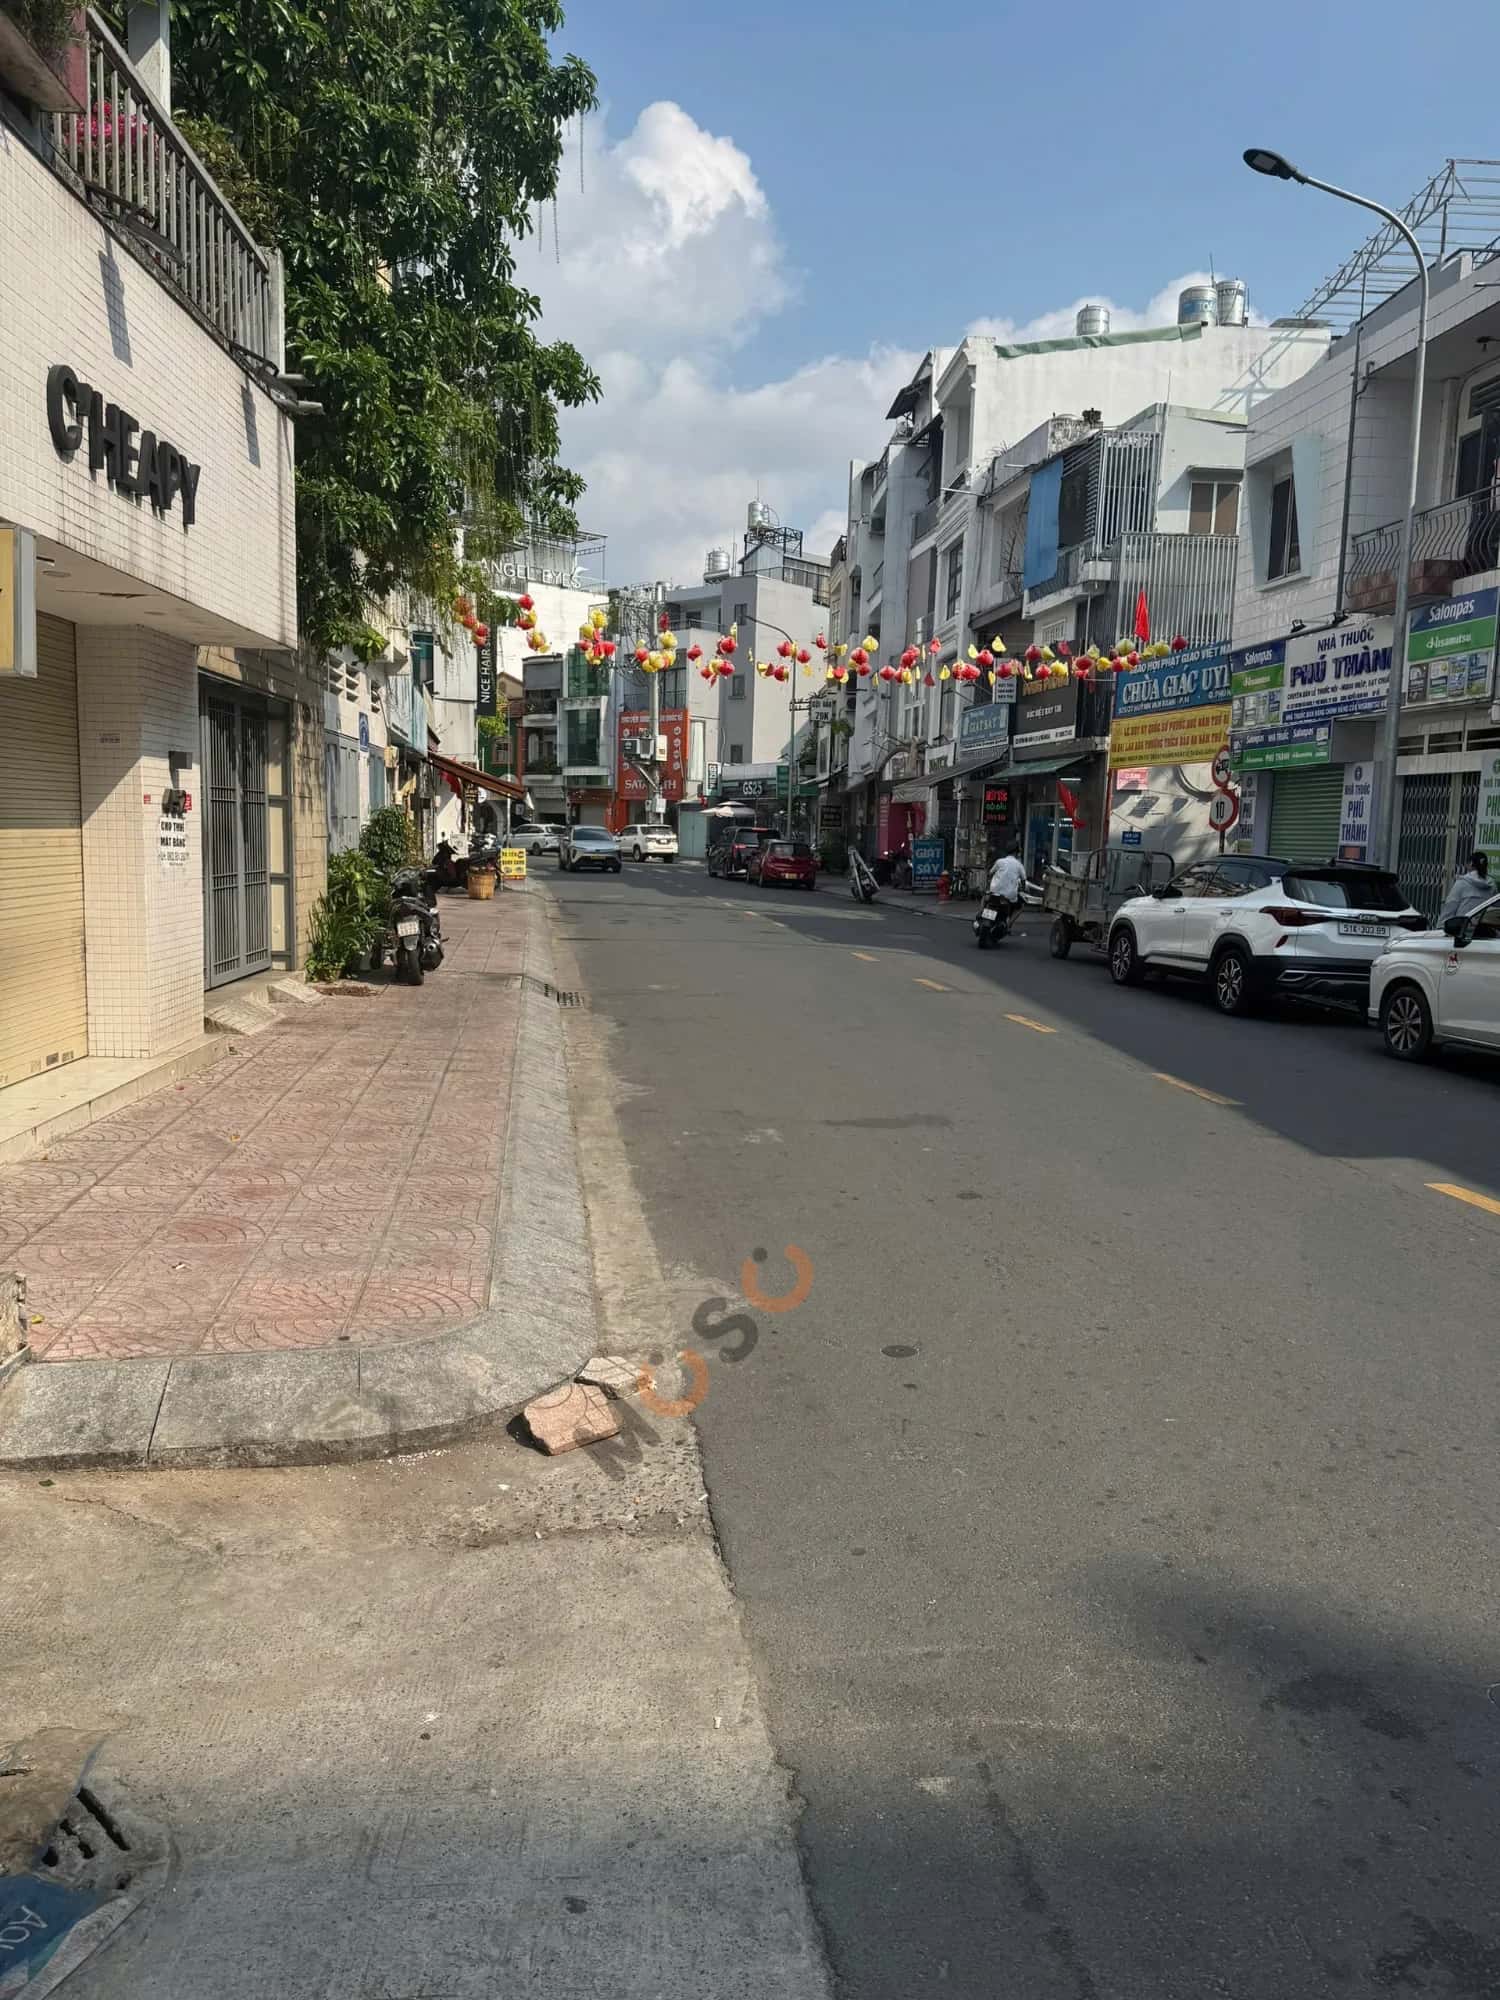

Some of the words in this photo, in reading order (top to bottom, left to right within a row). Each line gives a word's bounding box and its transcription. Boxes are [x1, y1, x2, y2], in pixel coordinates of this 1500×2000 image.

[47, 364, 200, 524] CHEAPY
[481, 558, 536, 580] ANGEL
[542, 568, 581, 589] EYES
[1428, 600, 1475, 623] Salonpas
[1317, 633, 1336, 652] NHÀ
[1339, 623, 1374, 647] THUỐC
[481, 648, 490, 675] HAIR
[1244, 649, 1272, 666] Salonpas
[1290, 654, 1327, 688] PHÚ
[481, 677, 490, 703] NICE
[1123, 674, 1160, 704] CHÙA
[1162, 665, 1199, 698] GIÁC
[742, 781, 763, 795] GS25
[1215, 801, 1225, 819] 10
[1347, 796, 1364, 818] PHÚ
[1341, 819, 1367, 841] THÀNH
